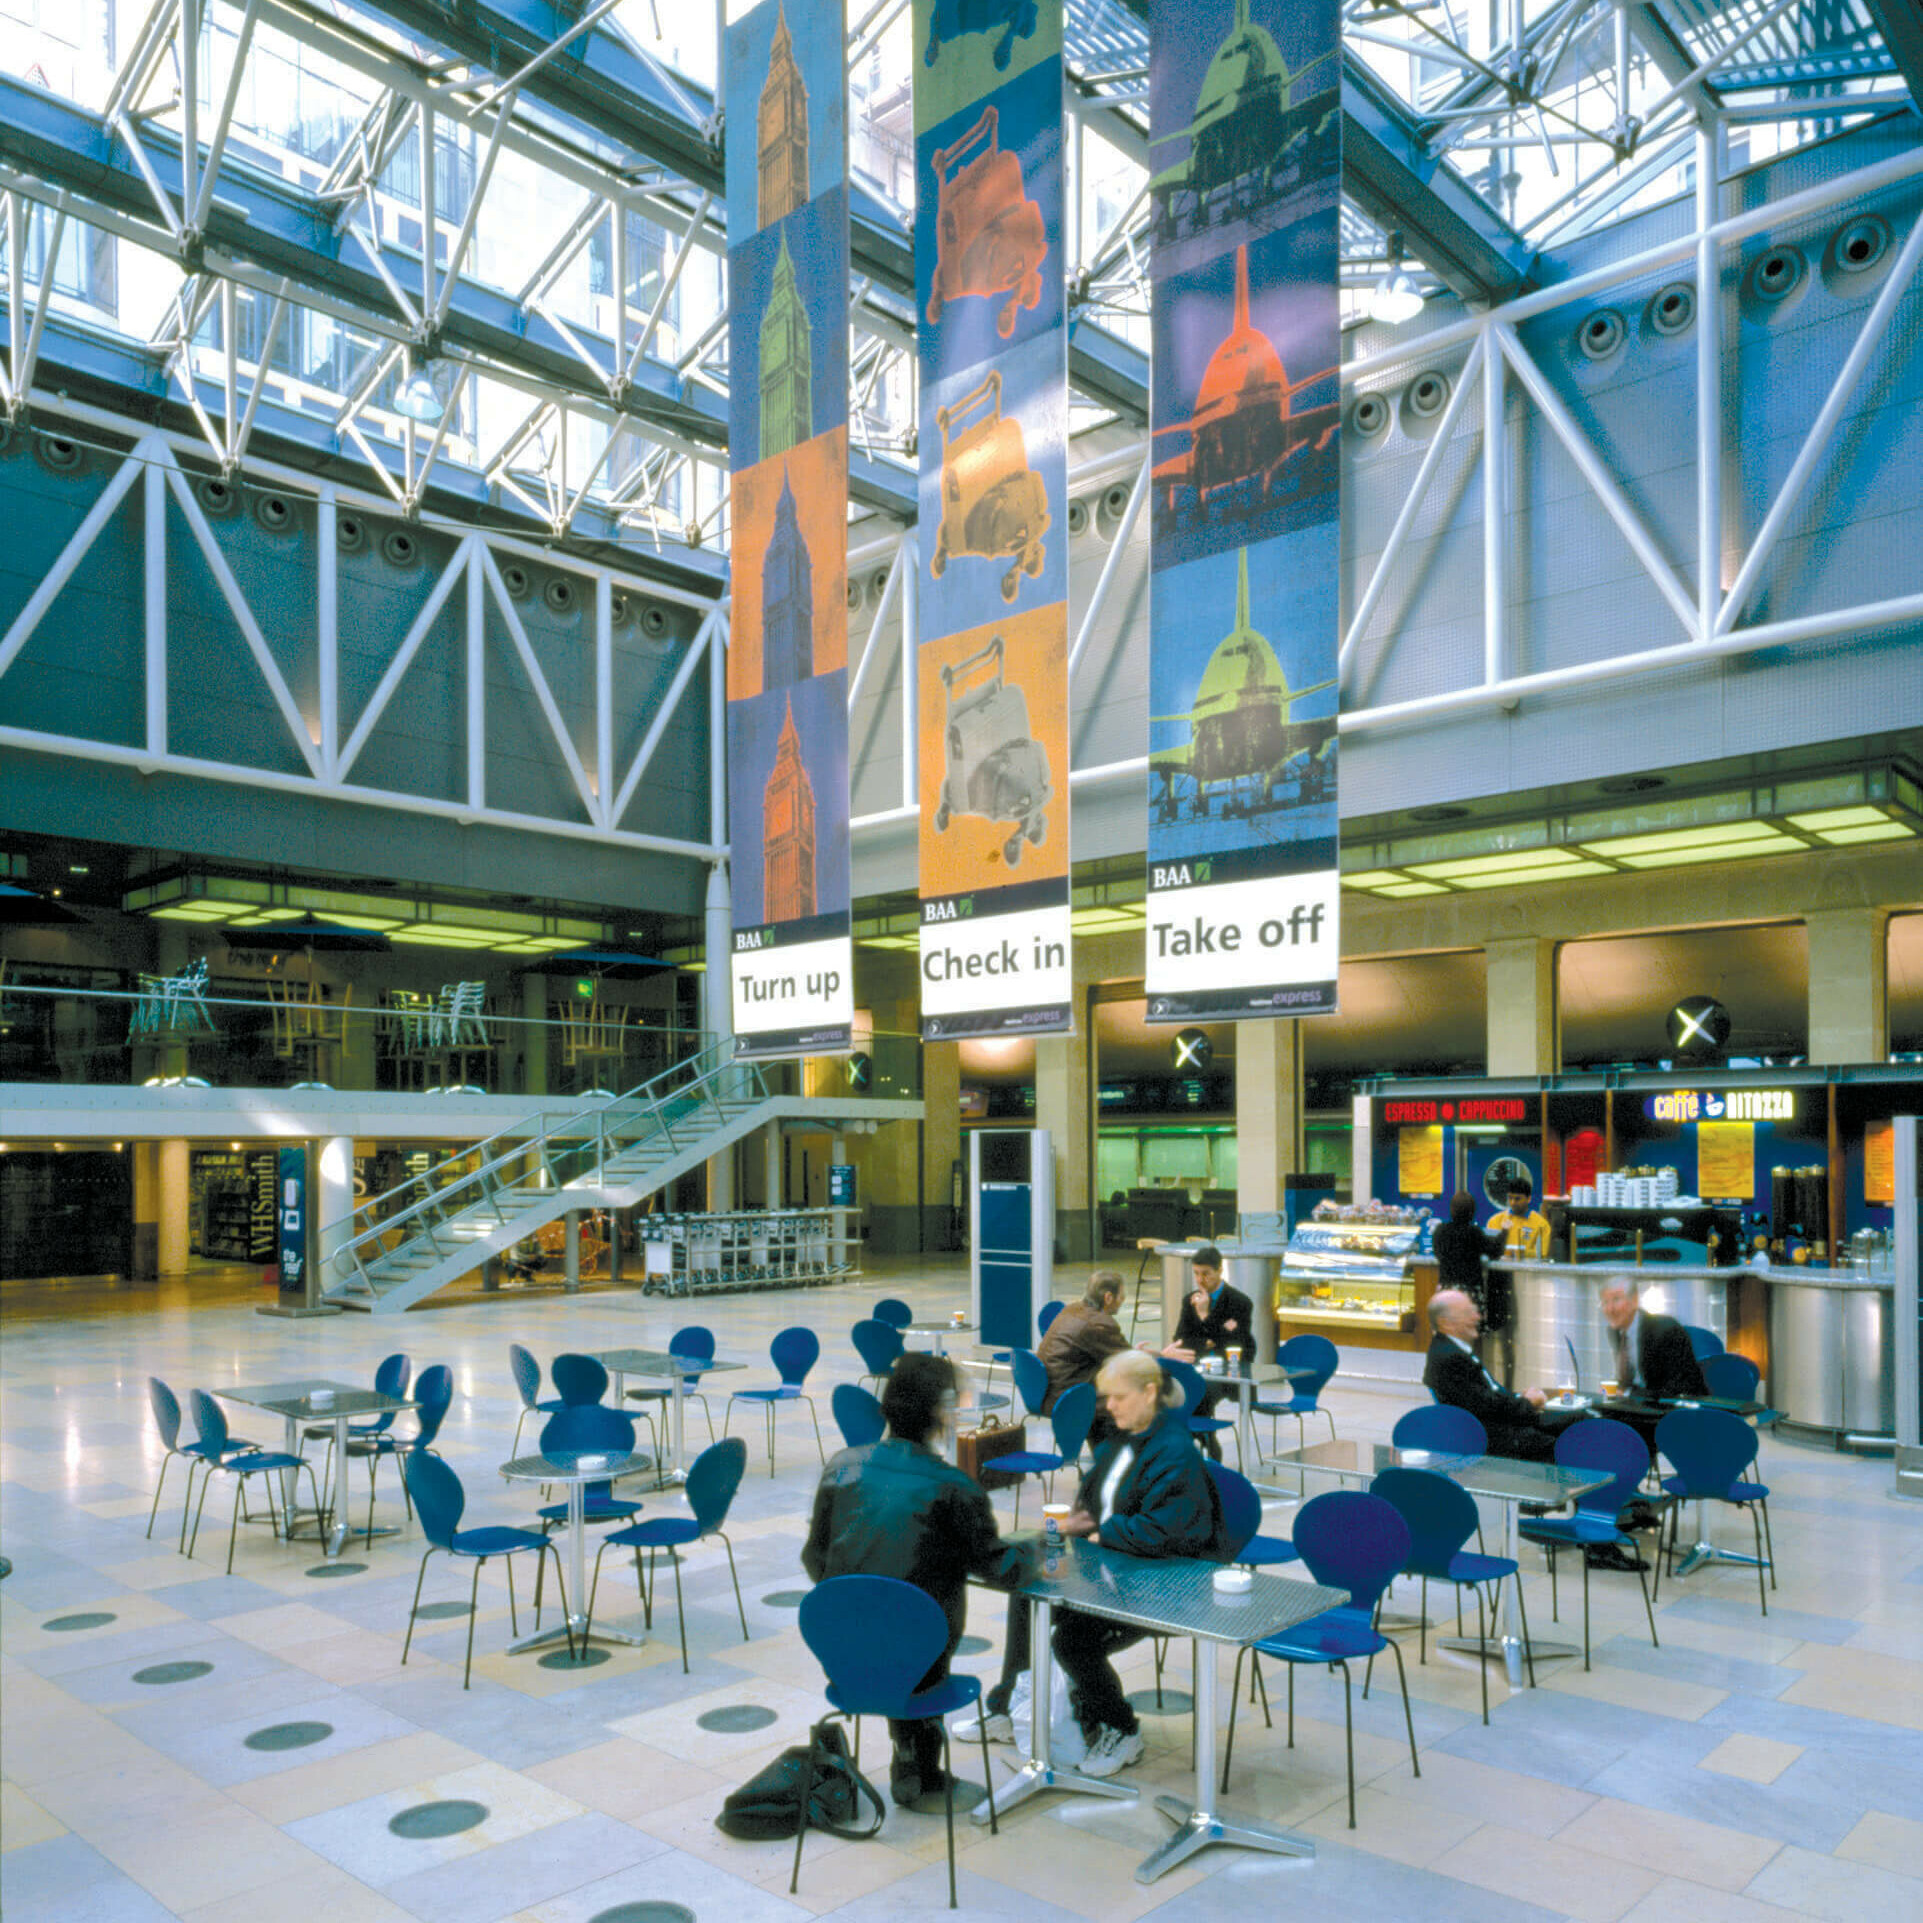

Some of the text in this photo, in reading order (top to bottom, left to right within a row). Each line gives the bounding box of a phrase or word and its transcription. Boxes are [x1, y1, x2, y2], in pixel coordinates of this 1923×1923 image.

[1153, 864, 1191, 888] BAA
[924, 900, 957, 922] BAA
[736, 931, 762, 950] BAA
[1153, 902, 1325, 957] Take off
[923, 935, 1065, 982] Check in
[740, 970, 840, 1003] Turn up
[1273, 990, 1322, 1006] express
[1385, 1100, 1525, 1123] ESPRESSO CAPPUCCINO
[250, 1154, 274, 1258] WHSmith
